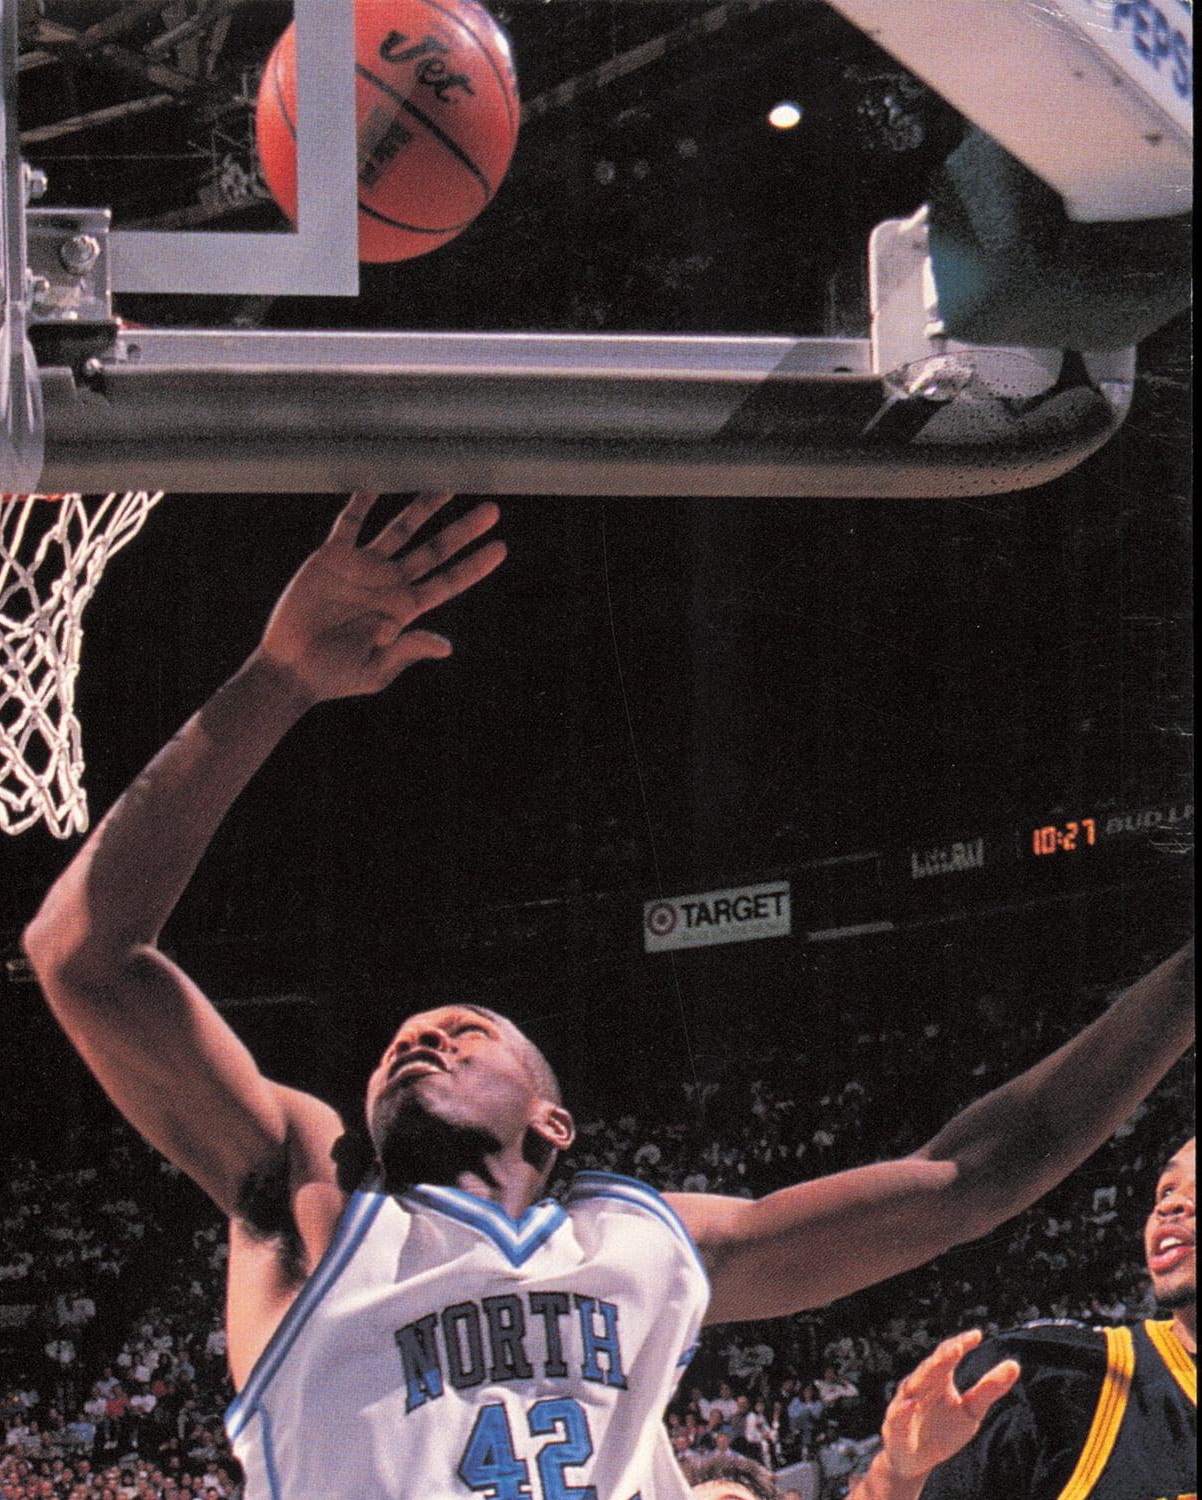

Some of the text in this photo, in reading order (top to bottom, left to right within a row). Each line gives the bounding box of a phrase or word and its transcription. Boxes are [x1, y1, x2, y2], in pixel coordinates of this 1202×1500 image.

[1033, 818, 1095, 856] 10:27
[680, 890, 788, 928] TARGET
[394, 1291, 627, 1414] NORTH
